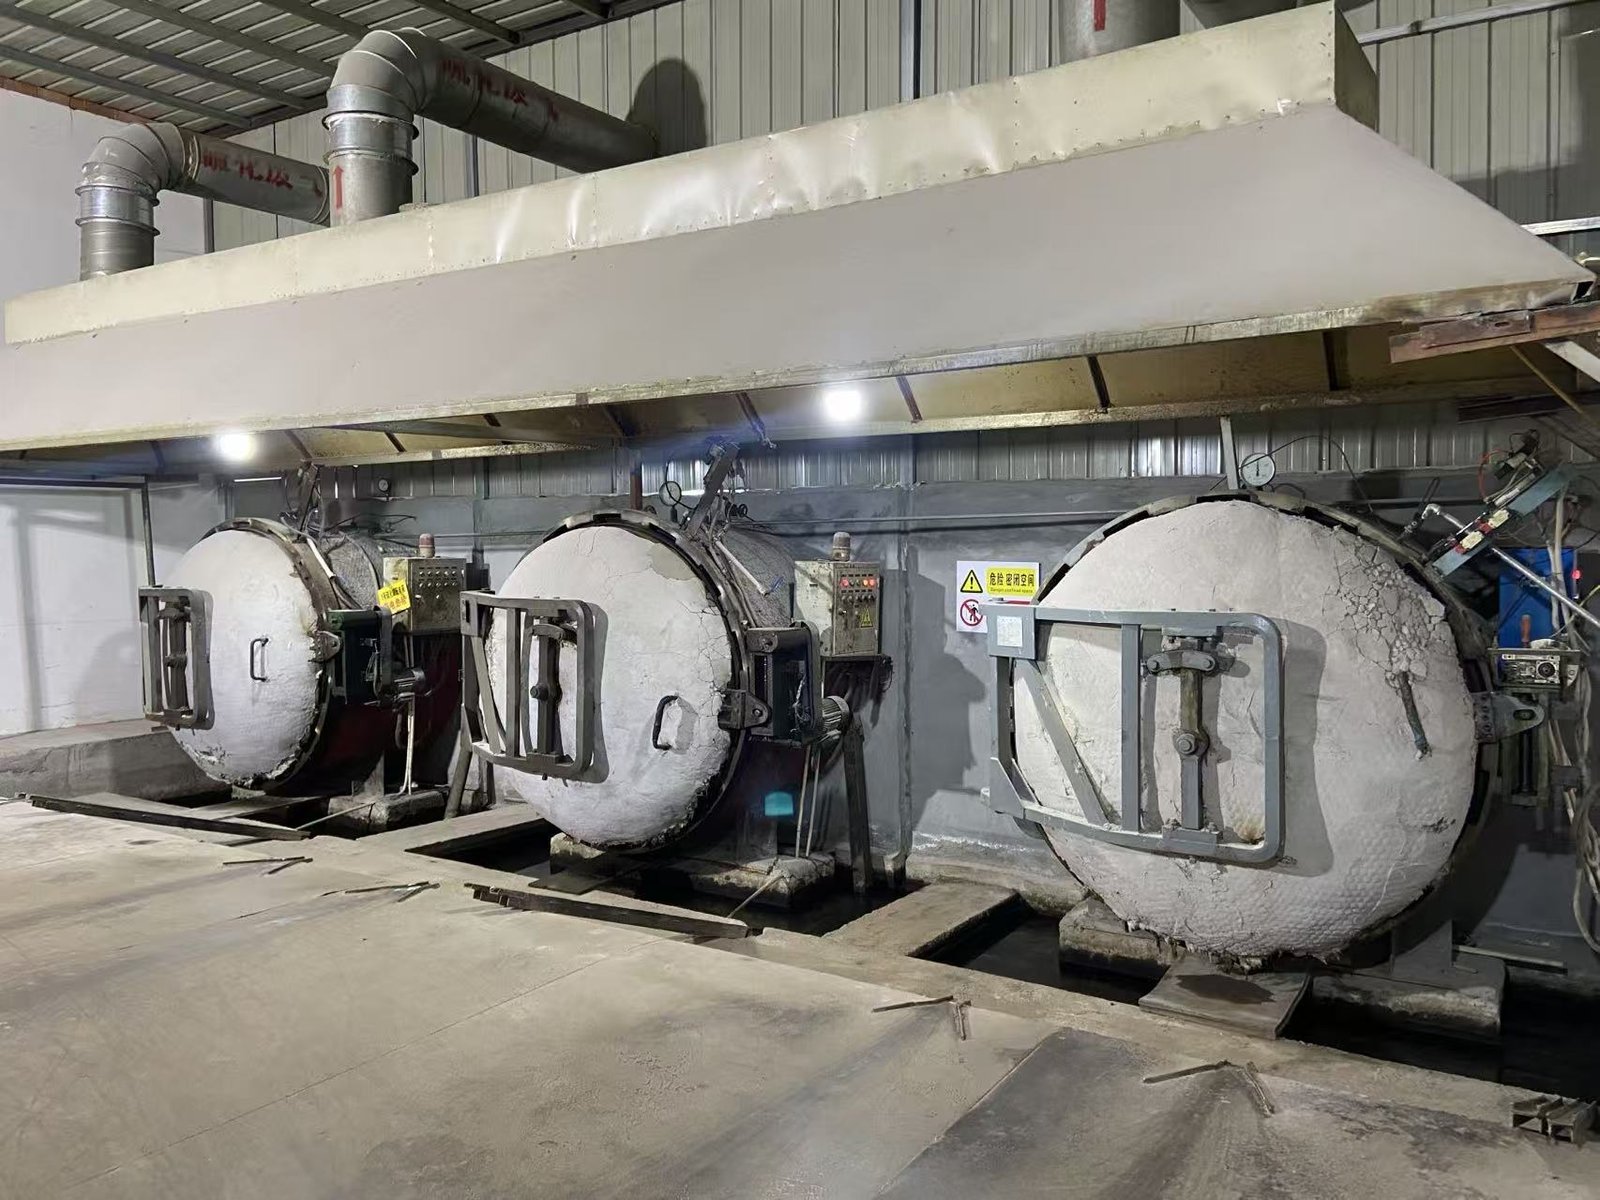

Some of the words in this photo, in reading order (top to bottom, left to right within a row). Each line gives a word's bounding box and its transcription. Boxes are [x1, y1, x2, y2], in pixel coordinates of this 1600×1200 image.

[989, 572, 1004, 586] 危险
[1005, 573, 1035, 587] 密闭空间
